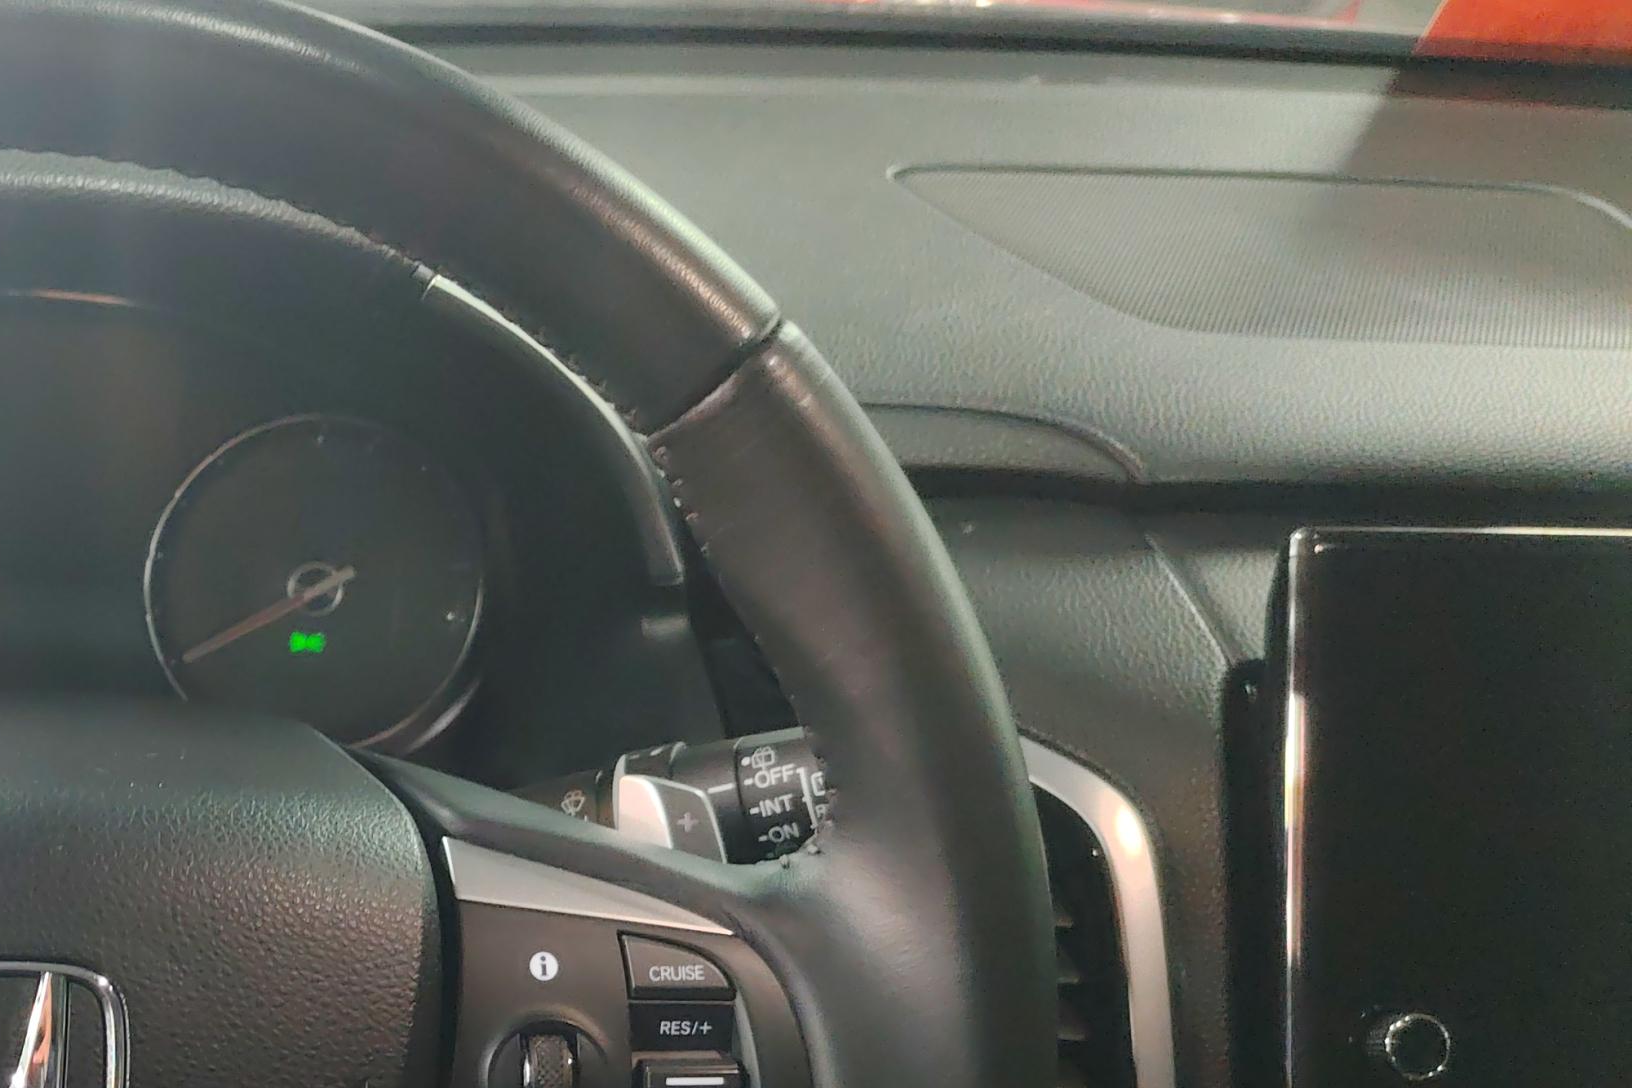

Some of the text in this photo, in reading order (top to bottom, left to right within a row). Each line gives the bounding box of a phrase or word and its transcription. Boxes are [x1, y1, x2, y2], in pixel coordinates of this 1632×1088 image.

[755, 765, 796, 788] OFF
[759, 795, 792, 817] INT
[769, 823, 799, 842] ON
[649, 965, 706, 982] CRUISE
